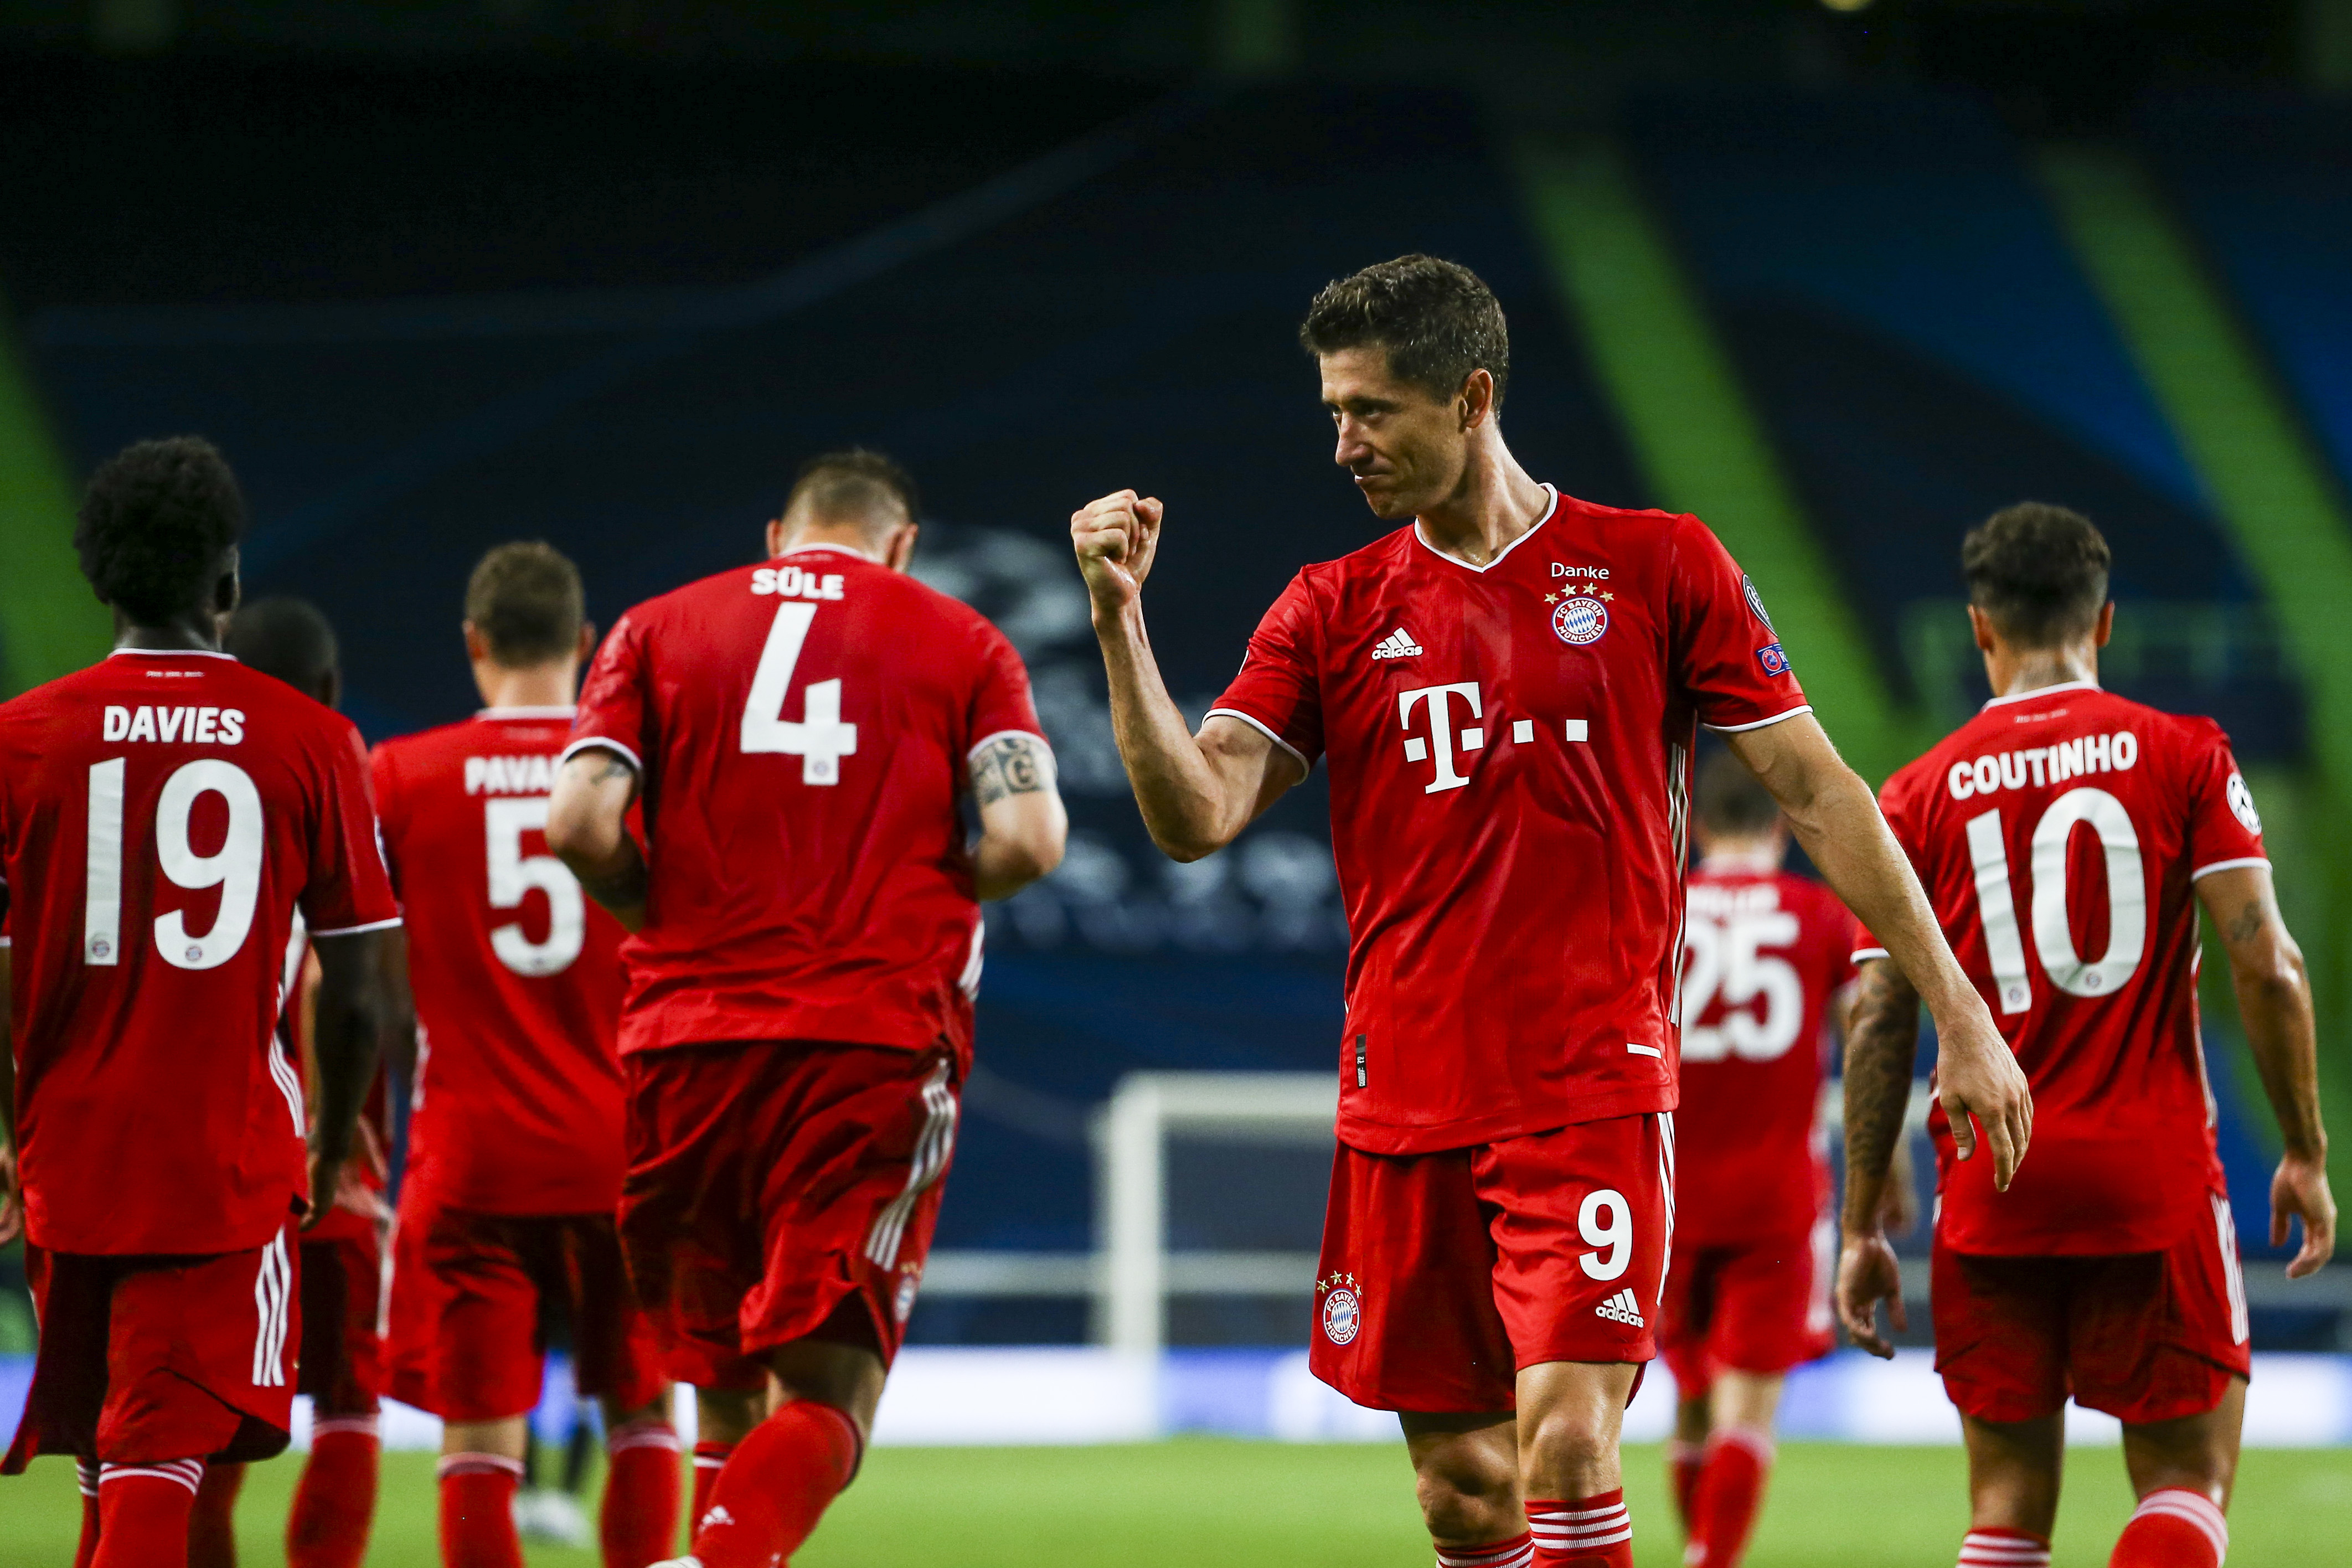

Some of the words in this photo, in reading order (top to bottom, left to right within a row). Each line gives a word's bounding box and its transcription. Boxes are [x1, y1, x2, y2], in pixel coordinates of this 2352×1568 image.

[751, 566, 844, 601] SÜLE
[1551, 562, 1610, 579] Danke
[1557, 606, 1568, 619] FC
[1567, 600, 1603, 617] BAYERN
[1371, 646, 1423, 660] adidas
[740, 601, 857, 786] 4
[103, 705, 245, 745] DAVIES
[1948, 731, 2138, 800] COUTINHO
[85, 757, 264, 970] 19
[485, 797, 586, 977] 5
[1966, 787, 2146, 1015] 10
[1681, 911, 1805, 1062] 25
[1577, 1189, 1633, 1281] 9
[1327, 1299, 1335, 1312] FC
[1334, 1292, 1358, 1315] BAYERN
[1595, 1306, 1644, 1328] adidas
